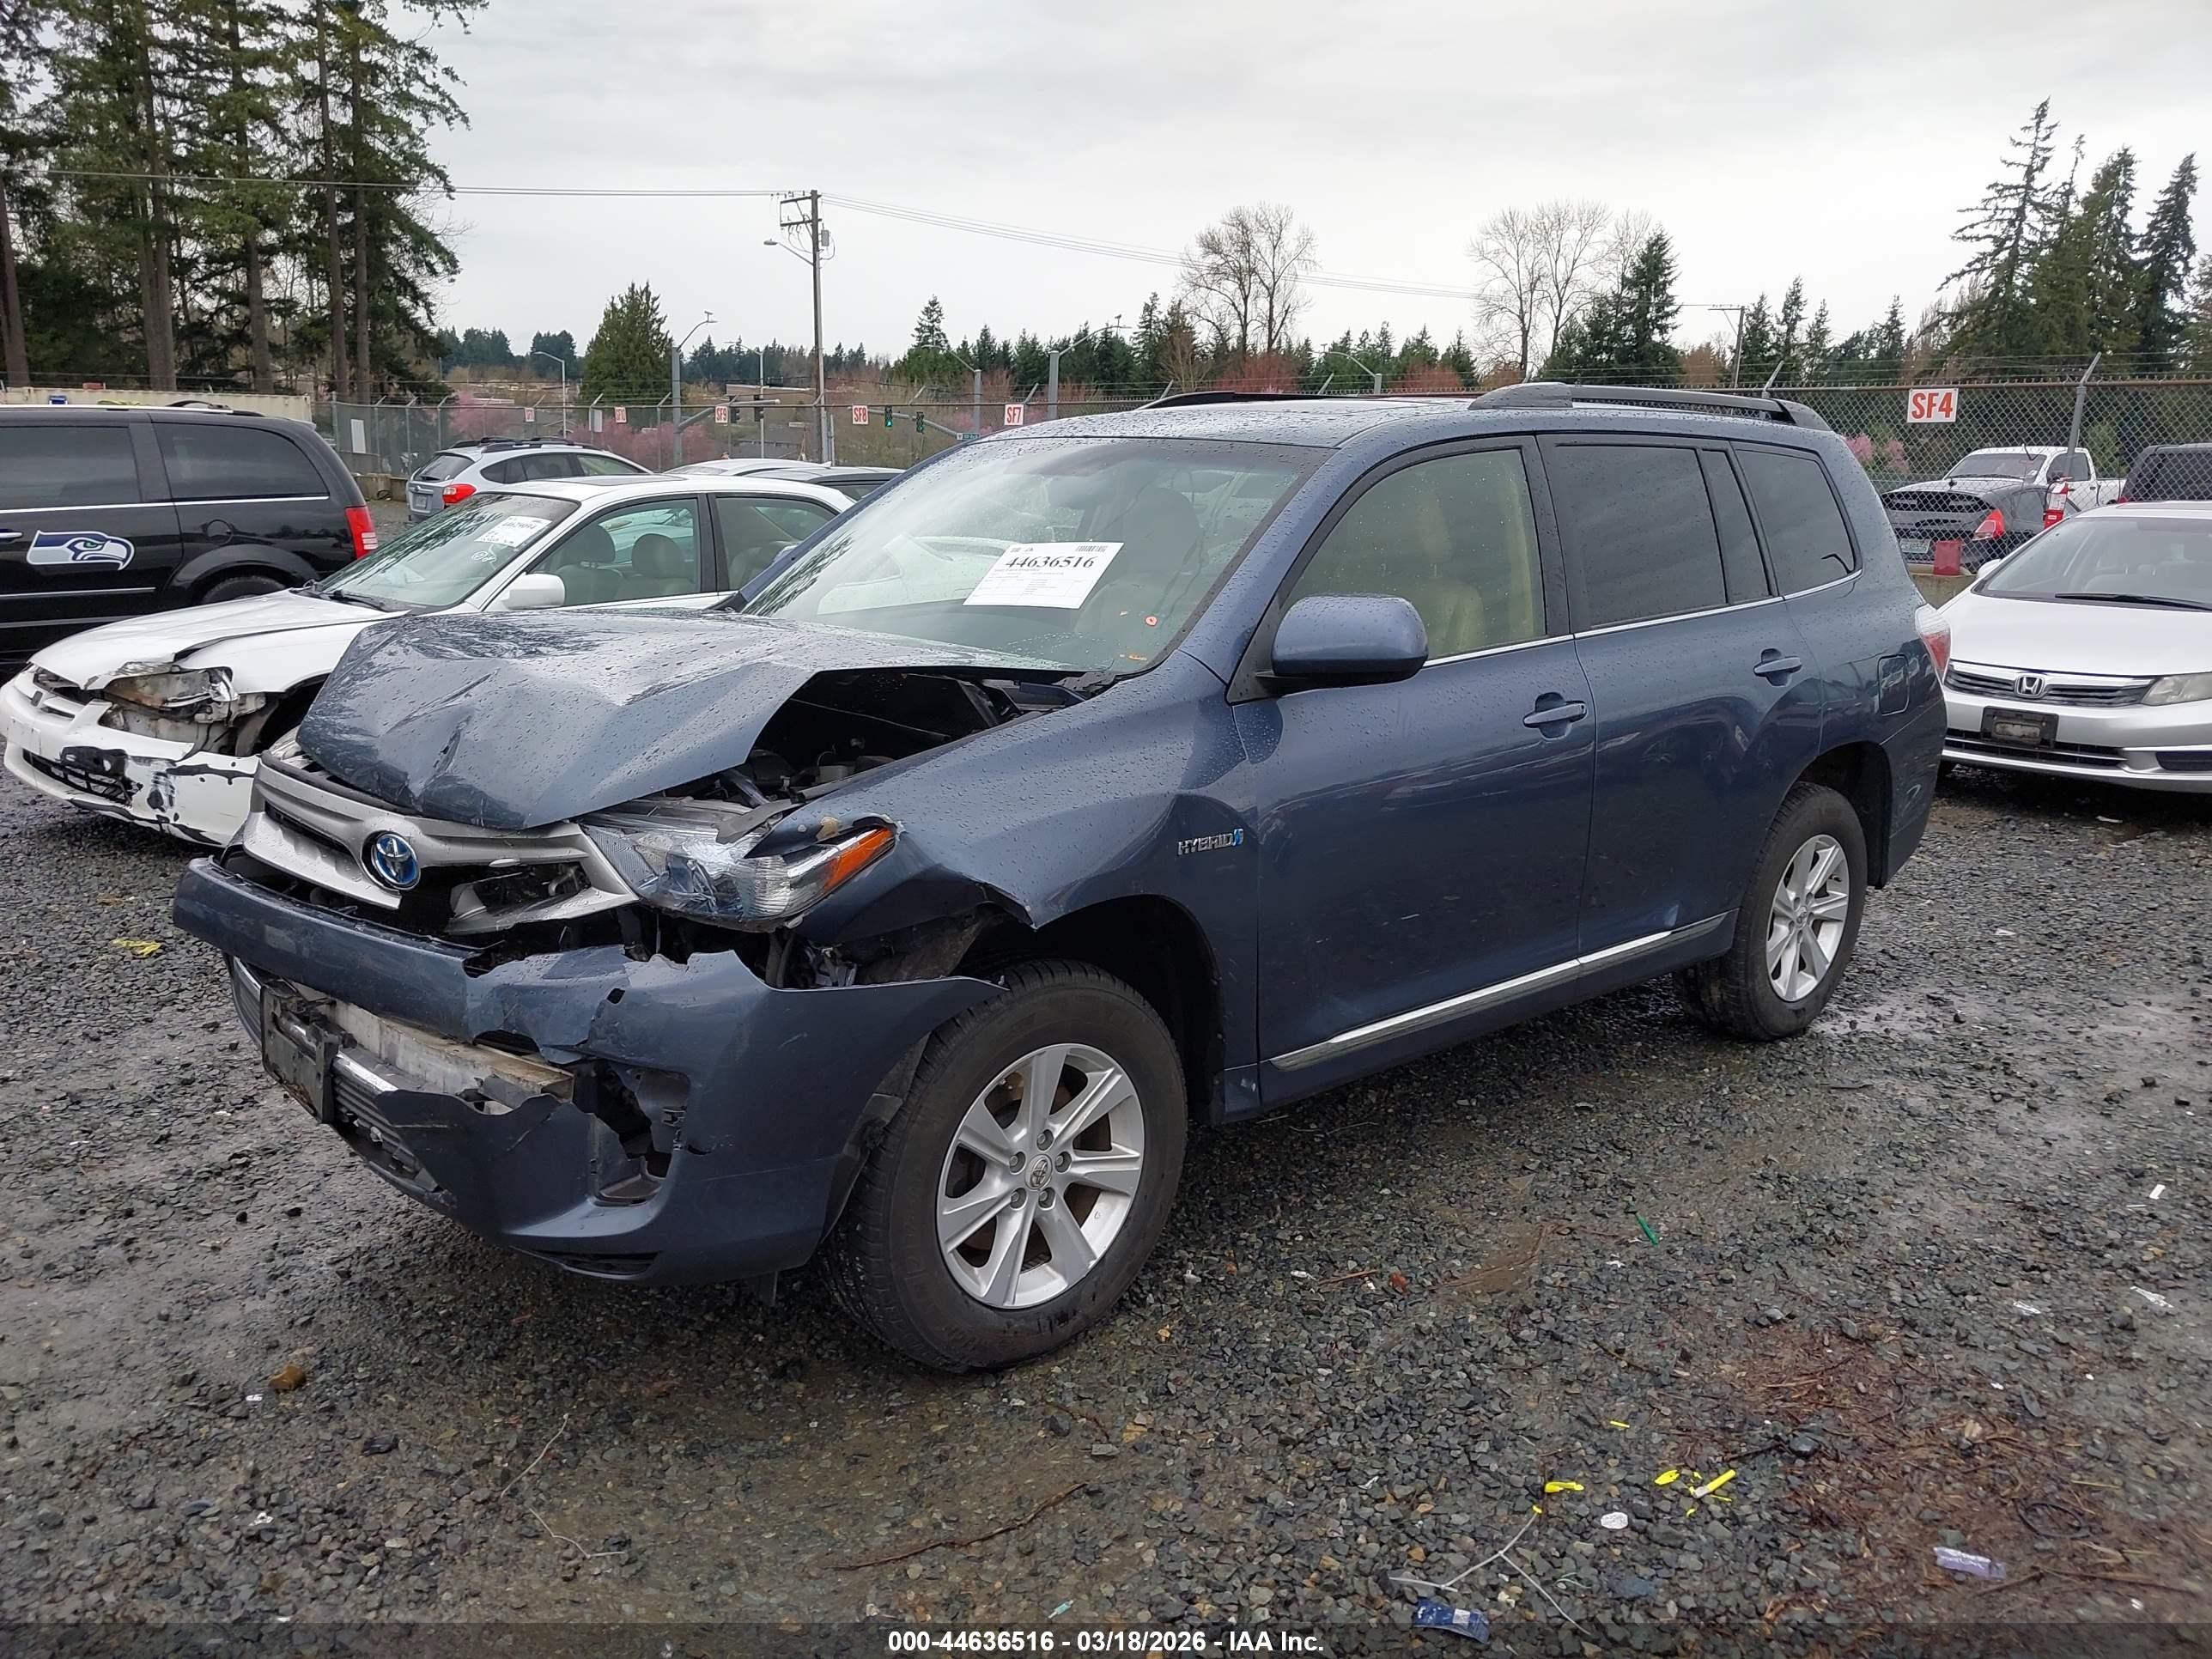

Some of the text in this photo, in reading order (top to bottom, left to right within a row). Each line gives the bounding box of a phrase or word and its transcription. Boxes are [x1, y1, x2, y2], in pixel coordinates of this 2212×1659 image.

[1911, 392, 1954, 419] SF4
[716, 408, 727, 422] SF9
[854, 407, 867, 422] SF8
[1006, 406, 1022, 423] SF7
[1005, 556, 1099, 568] 44636516
[1177, 832, 1235, 855] HYBRID
